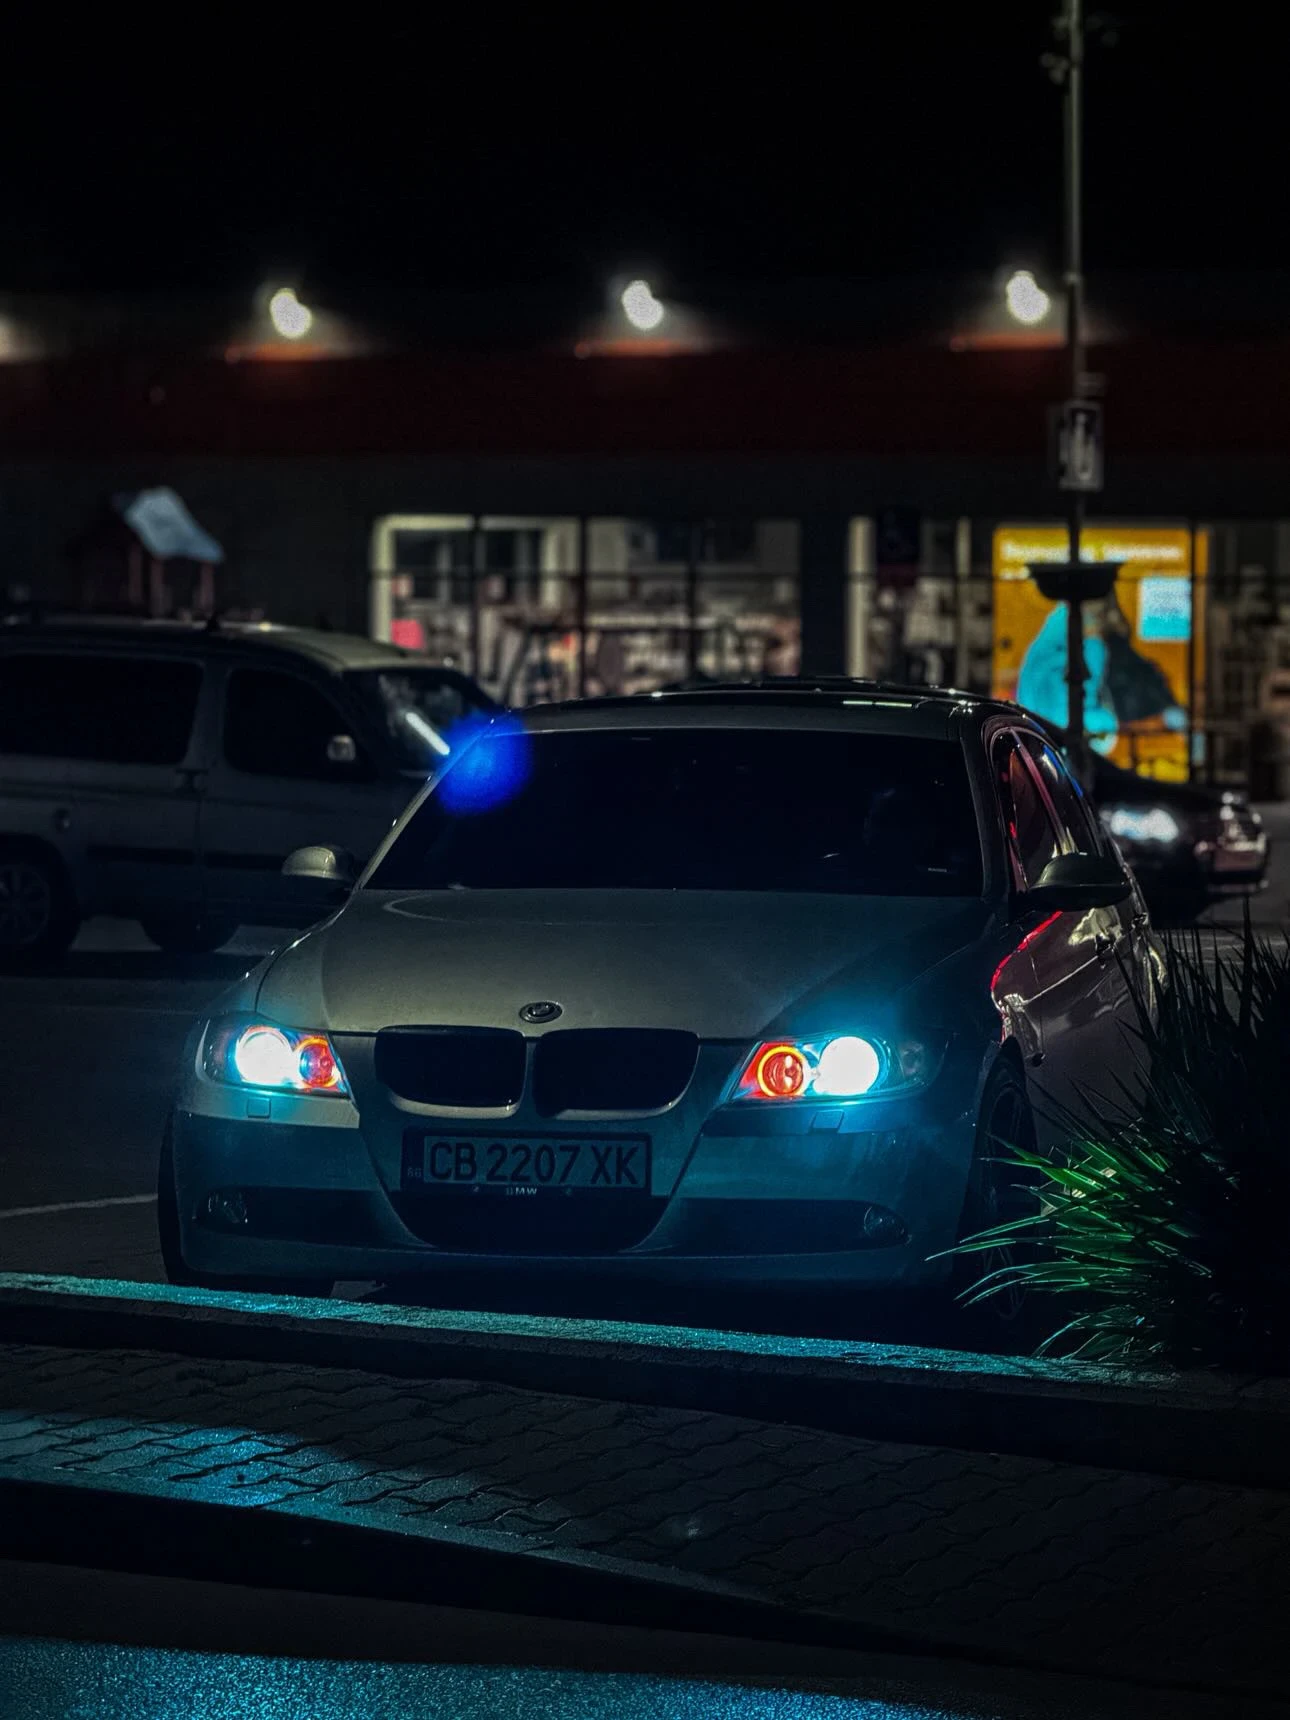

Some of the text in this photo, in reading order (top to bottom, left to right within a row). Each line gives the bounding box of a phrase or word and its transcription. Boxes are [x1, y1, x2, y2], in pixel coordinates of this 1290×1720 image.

[431, 1142, 639, 1185] CB 2207 XK
